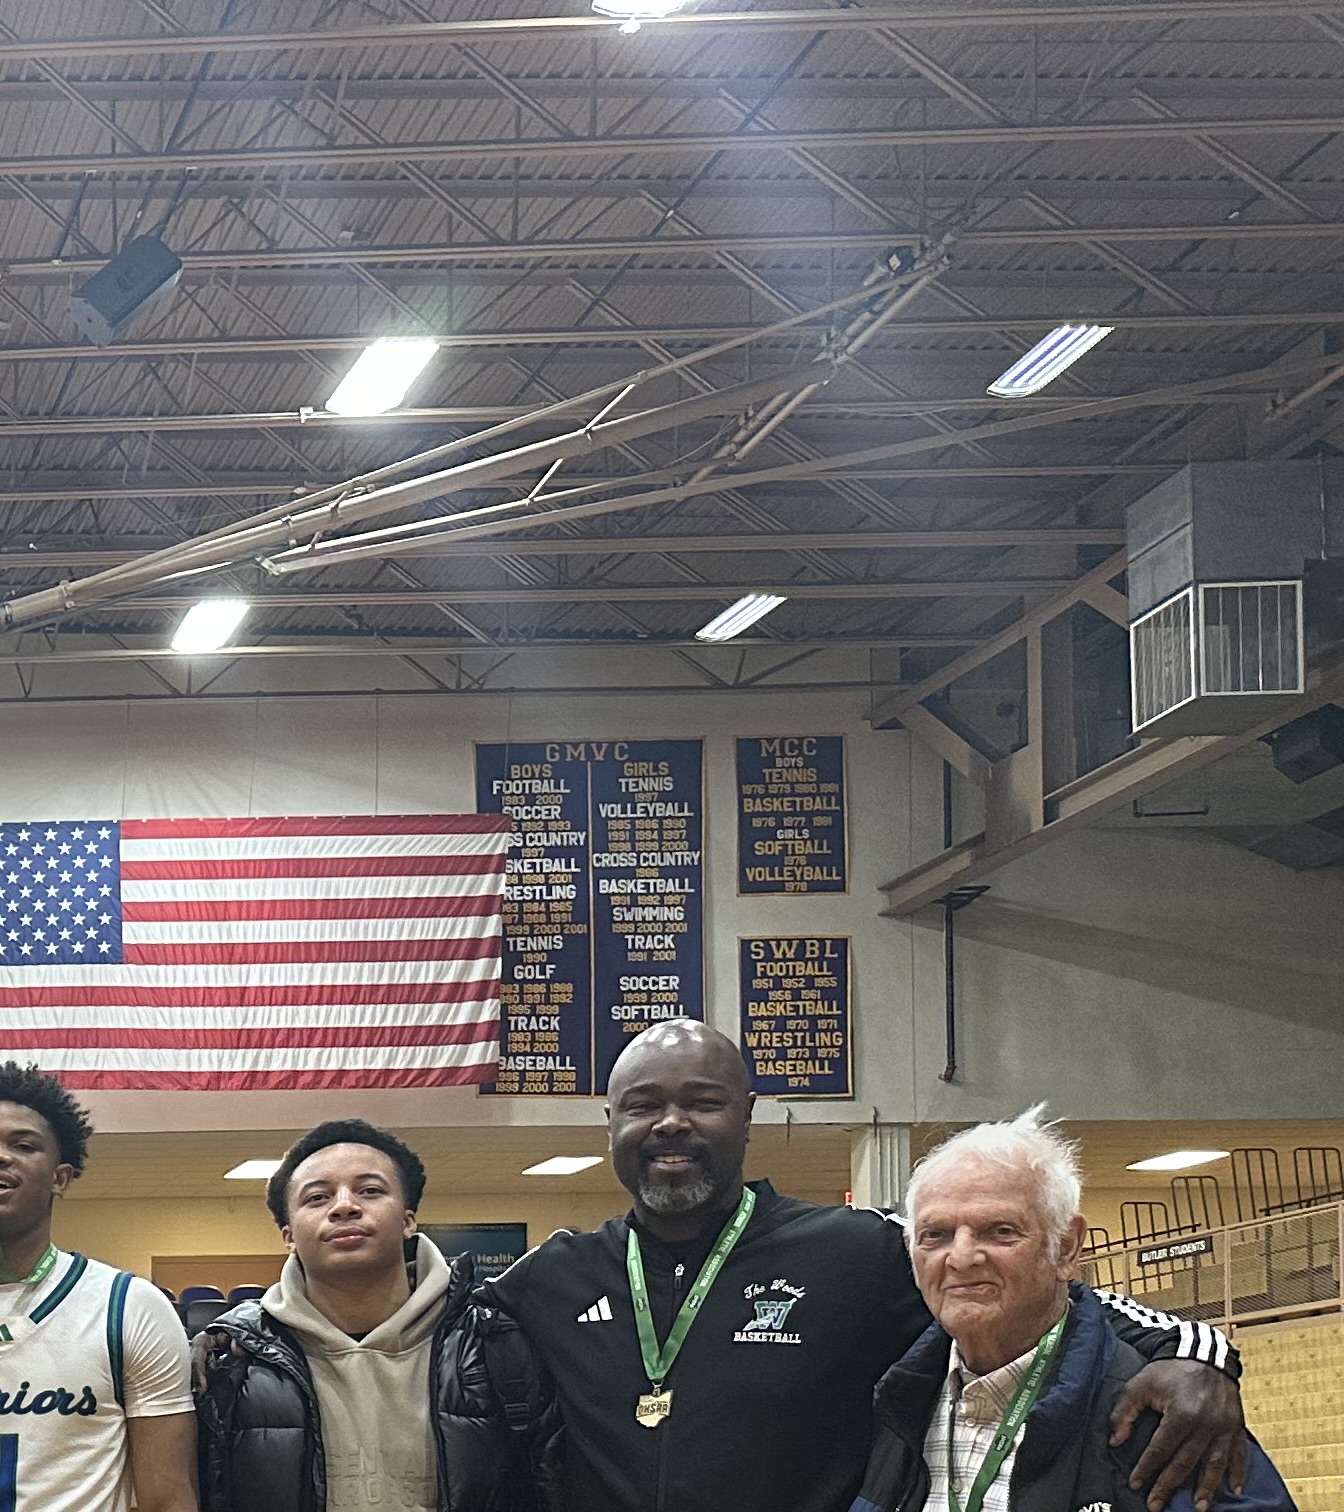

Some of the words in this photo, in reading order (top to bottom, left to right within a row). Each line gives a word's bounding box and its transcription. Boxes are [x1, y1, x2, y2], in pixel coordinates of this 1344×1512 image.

[760, 738, 816, 756] MCC
[624, 762, 669, 776] GIRLS
[776, 757, 804, 767] BOYS
[511, 764, 553, 778] BOYS
[762, 768, 817, 783] TENNIS
[492, 779, 571, 795] FOOTBALL
[618, 777, 674, 792] TENNIS
[599, 803, 694, 818] VOLLEYBALL
[744, 796, 840, 813] BASKETBALL
[526, 831, 586, 847] COUNTRY
[776, 829, 809, 839] GIRLS
[754, 840, 832, 855] SOFTBALL
[592, 852, 637, 868] CROSS
[639, 851, 700, 866] COUNTRY
[745, 866, 841, 882] VOLLEYBALL
[599, 878, 695, 893] BASKETBALL
[613, 906, 685, 922] SWIMMING
[506, 936, 563, 951] TENNIS
[624, 935, 675, 950] TRACK
[514, 964, 557, 980] GOLF
[757, 961, 833, 976] FOOTBALL
[619, 976, 680, 991] SOCCER
[611, 1004, 689, 1019] SOFTBALL
[748, 1001, 842, 1017] BASKETBALL
[508, 1016, 560, 1031] TRACK
[744, 1032, 843, 1047] WRESTLING
[756, 1060, 834, 1075] BASEBALL
[476, 1253, 514, 1263] Health
[1142, 1248, 1168, 1263] BUTLER
[1169, 1240, 1206, 1258] STUDENTS
[743, 1284, 765, 1300] The
[770, 1279, 807, 1299] Woods
[733, 1332, 802, 1343] BASKETBALL
